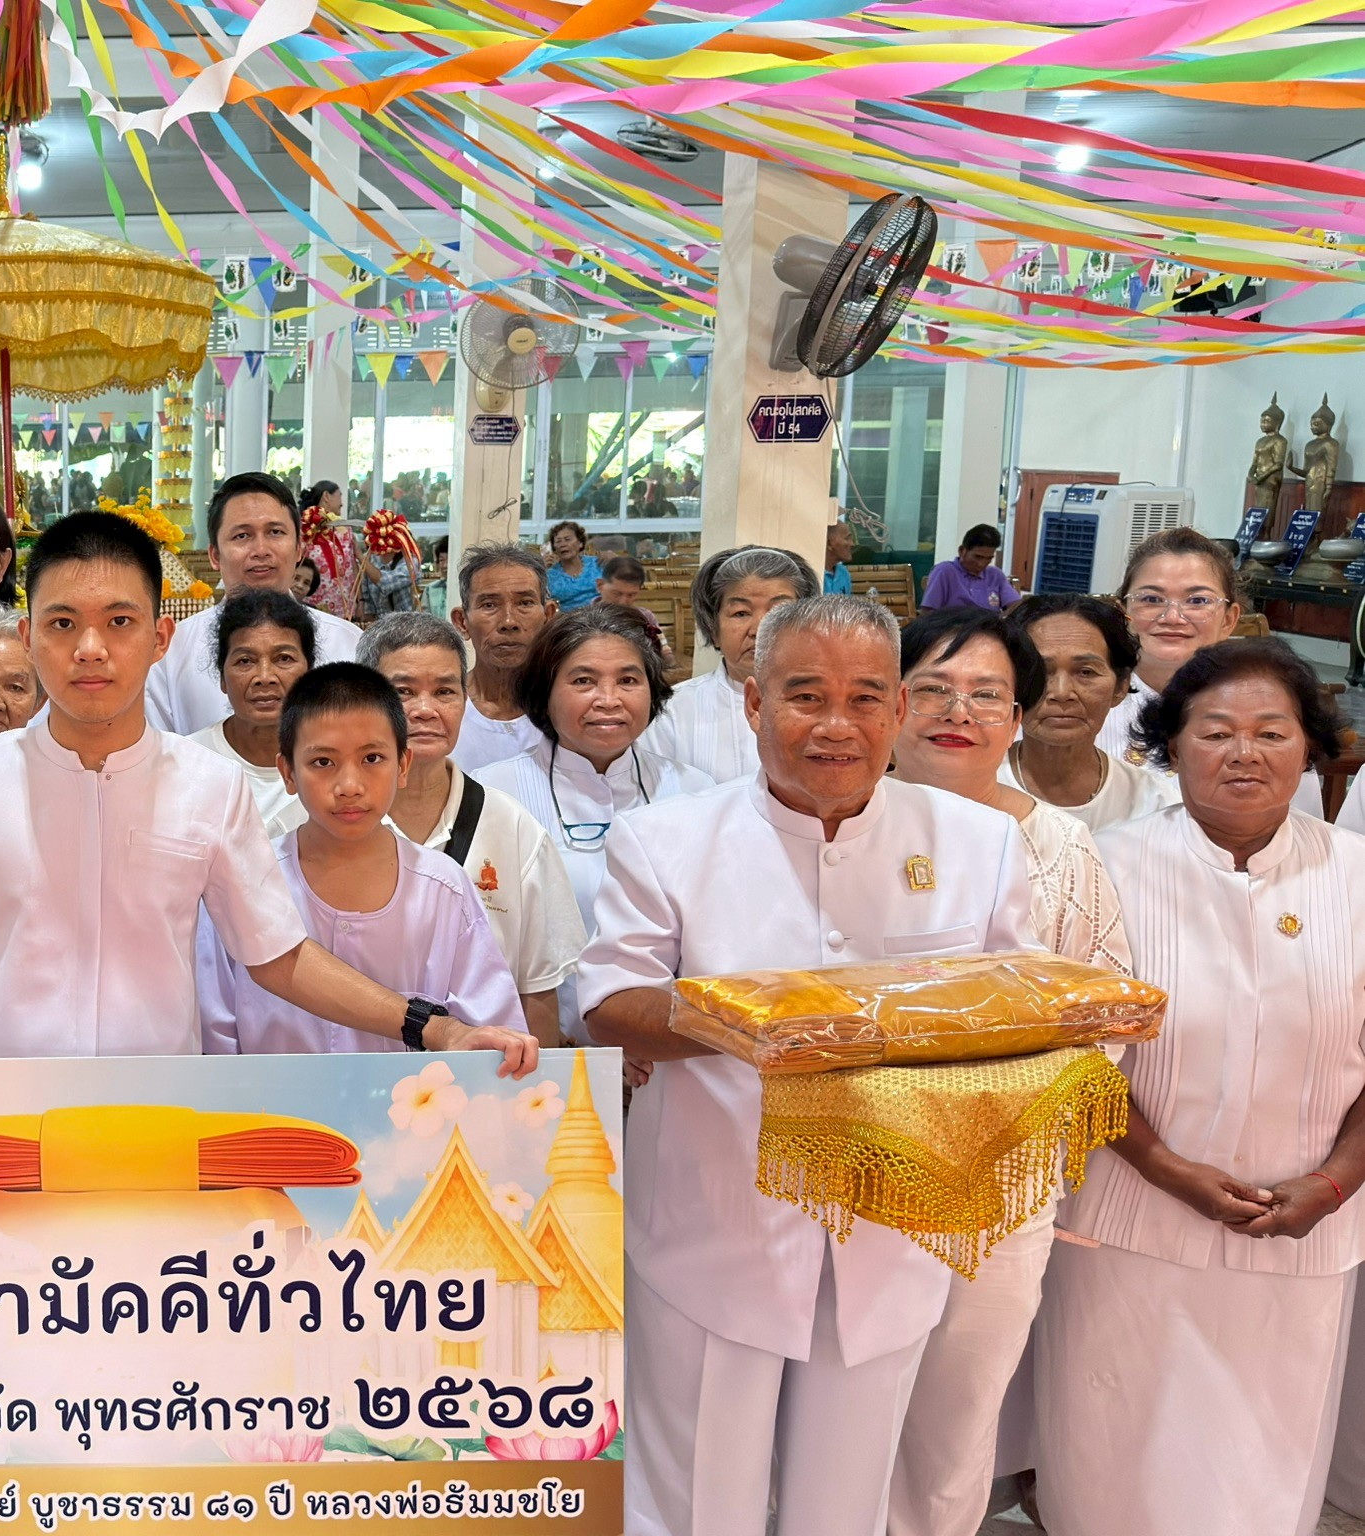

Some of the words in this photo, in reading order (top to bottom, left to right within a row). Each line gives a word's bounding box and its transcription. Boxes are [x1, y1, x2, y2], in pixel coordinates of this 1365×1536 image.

[788, 422, 801, 434] 54
[55, 1381, 330, 1450] พุทธศักราช
[354, 1376, 594, 1430] ๒๕๖๘
[32, 1496, 190, 1529] บูชาธรรม
[207, 1495, 254, 1518] ๘๑
[269, 1484, 291, 1516] ปี
[307, 1481, 581, 1517] หลวงพ่อธัมมชโย
